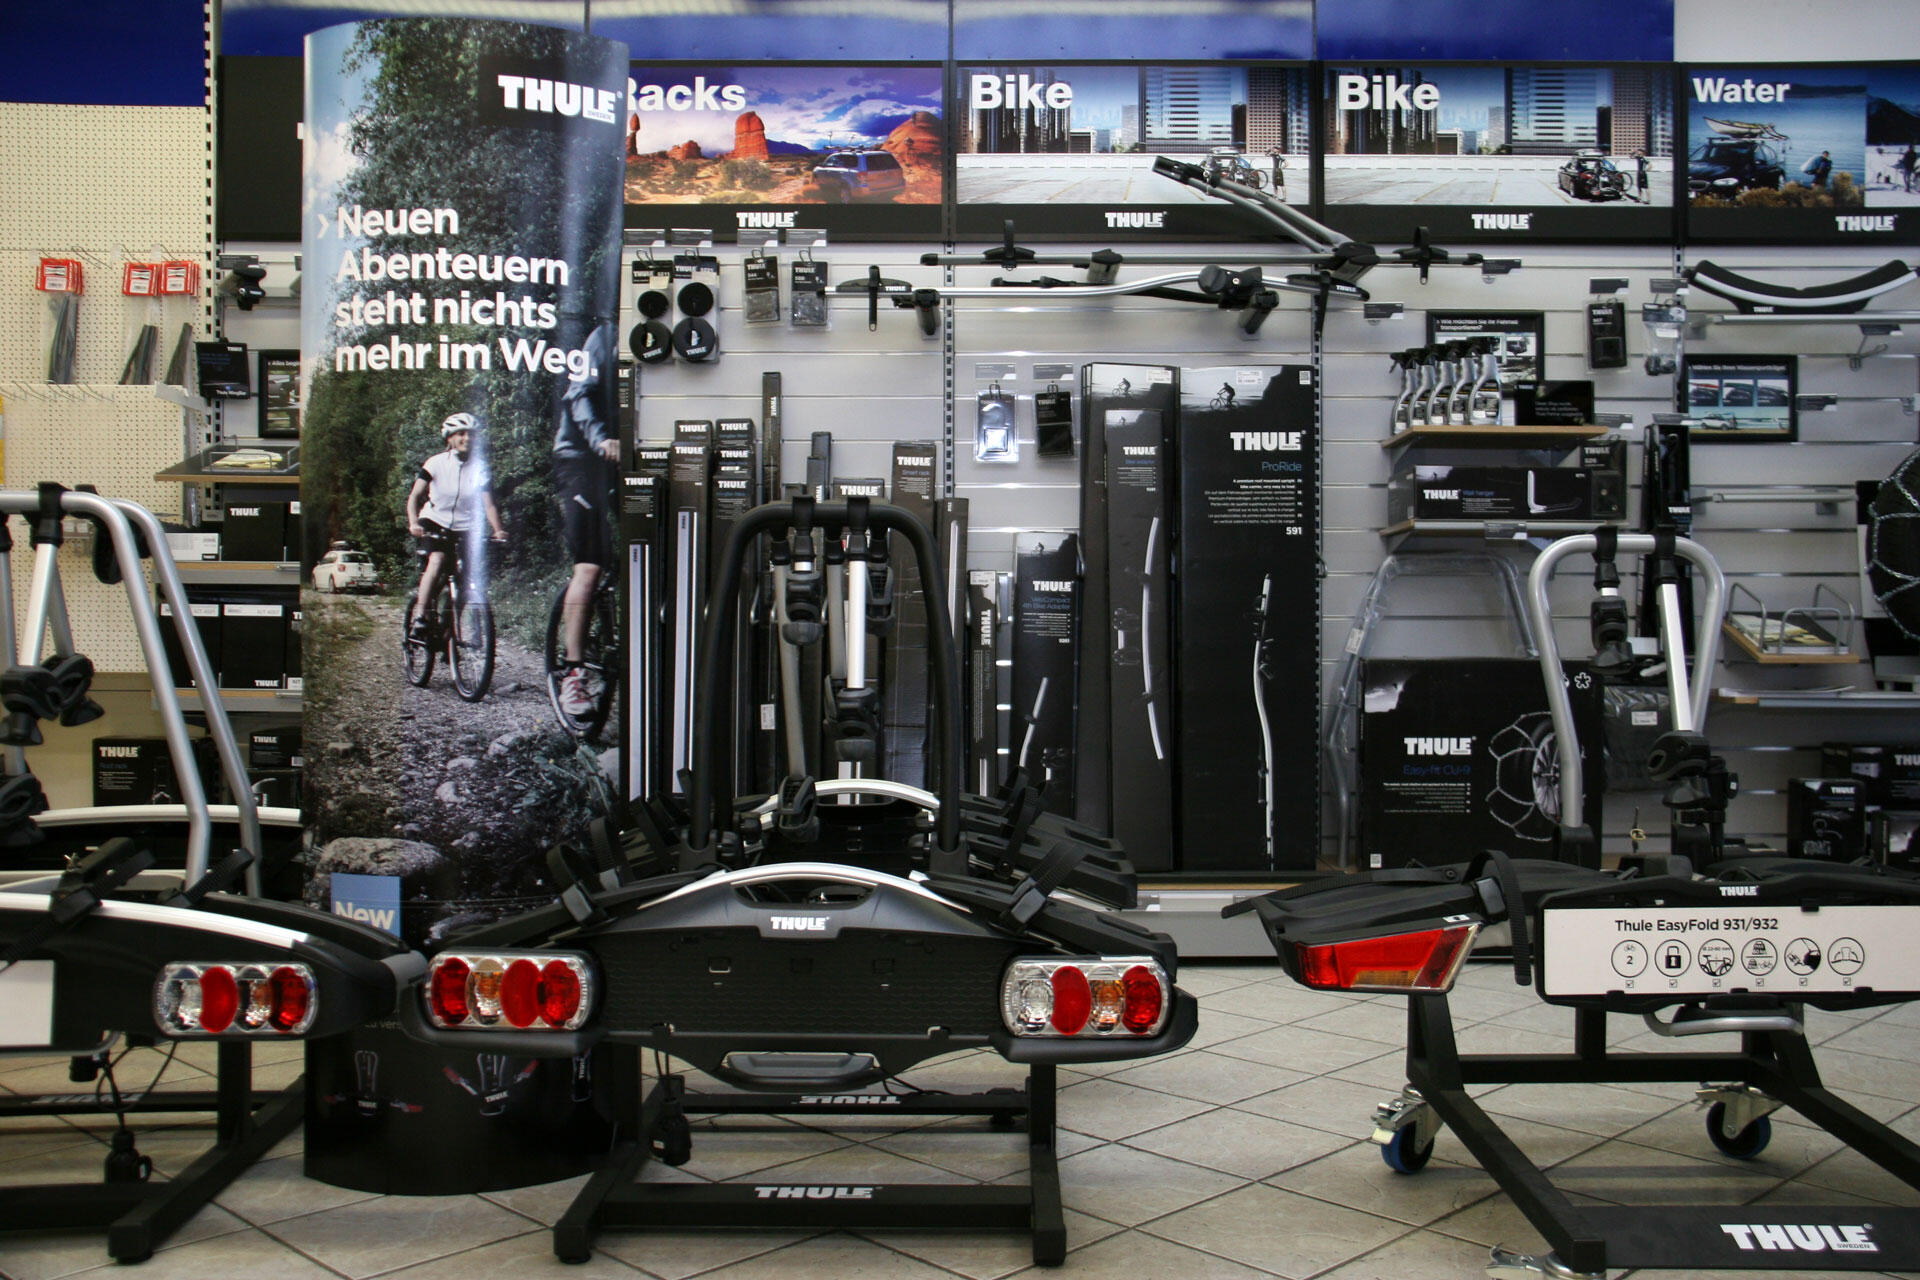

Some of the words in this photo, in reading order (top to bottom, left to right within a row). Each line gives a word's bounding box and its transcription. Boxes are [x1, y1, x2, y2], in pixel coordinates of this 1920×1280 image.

[971, 74, 1073, 109] Bike
[1338, 75, 1440, 110] Bike
[1693, 78, 1790, 104] Water
[498, 75, 616, 124] THULE
[337, 204, 459, 238] Neuen
[736, 212, 795, 228] THULE
[1105, 212, 1163, 228] THULE
[1472, 213, 1529, 229] THULE
[1836, 216, 1894, 231] THULE
[337, 247, 569, 286] Abenteuern
[335, 290, 427, 329] steht
[433, 290, 558, 330] nichts
[334, 334, 432, 373] mehr
[438, 334, 491, 371] im
[497, 337, 599, 382] Weg.
[679, 424, 707, 433] THULE
[720, 423, 749, 431] THULE
[1230, 431, 1301, 451] THULE
[640, 451, 669, 460] THULE
[674, 446, 704, 455] THULE
[720, 450, 749, 458] THULE
[1123, 446, 1156, 455] THULE
[897, 456, 931, 466] THULE
[1261, 461, 1302, 472] ProRide
[624, 477, 654, 486] THULE
[717, 480, 747, 489] THULE
[840, 485, 880, 496] THULE
[1423, 489, 1459, 499] THULE
[230, 507, 259, 516] THULE
[1286, 526, 1302, 535] 591
[1033, 580, 1072, 592] THULE
[981, 609, 991, 645] THULE
[254, 679, 279, 687] THULE
[99, 747, 138, 757] THULE
[1404, 737, 1472, 755] THULE
[1720, 886, 1757, 896] THULE
[335, 901, 395, 930] New
[770, 916, 826, 930] THULE
[1615, 919, 1653, 932] Thule
[1657, 918, 1719, 933] EasyFold
[1723, 918, 1779, 932] 931/932
[1626, 955, 1634, 965] 2
[800, 1095, 901, 1105] THULE
[755, 1186, 873, 1198] THULE
[1720, 1224, 1879, 1251] THULE
